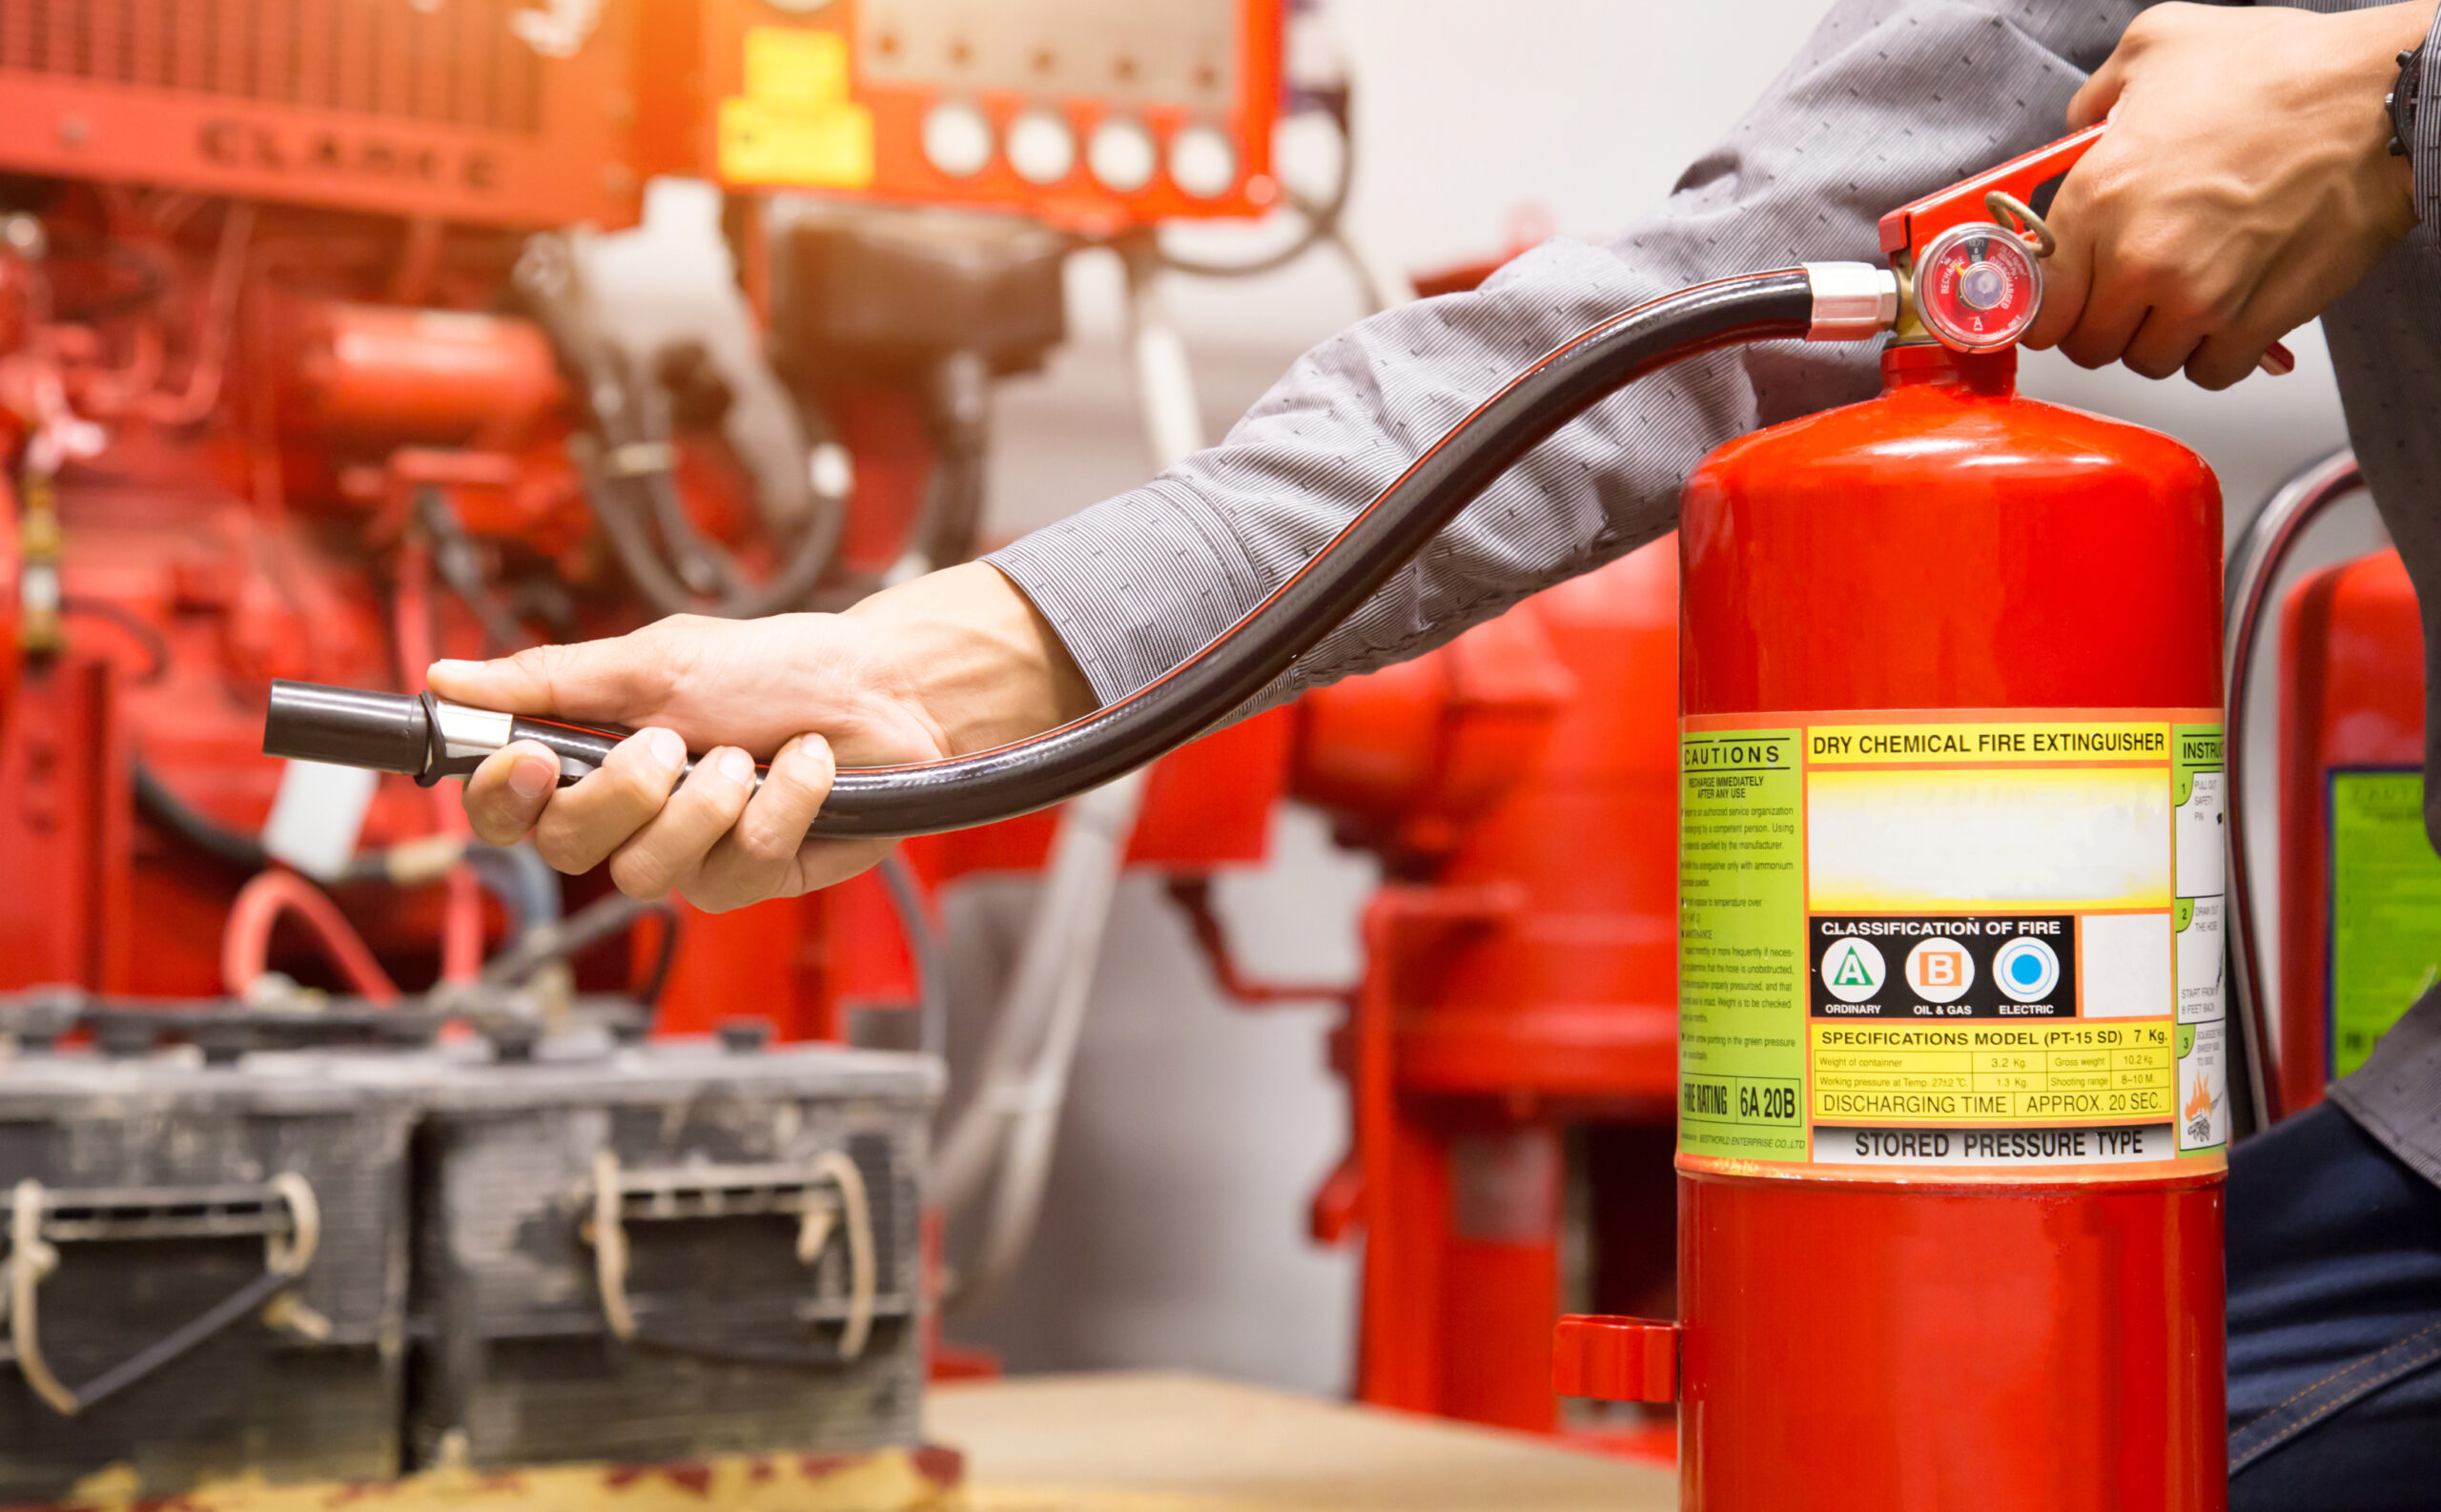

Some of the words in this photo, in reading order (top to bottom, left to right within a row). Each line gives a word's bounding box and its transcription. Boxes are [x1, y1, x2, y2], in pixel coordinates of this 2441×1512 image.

[1940, 255, 1965, 295] RECHARGE
[1814, 736, 1852, 754] DRY
[1859, 734, 1971, 753] CHEMICAL
[1979, 734, 2026, 752] FIRE
[2033, 733, 2164, 751] EXTINGUISHER
[1684, 746, 1779, 766] CAUTIONS
[1689, 777, 1715, 787] RECHARGE
[1716, 776, 1764, 787] IMMEDIATELY
[1697, 788, 1714, 799] AFTER
[1716, 788, 1729, 799] ANY
[1731, 788, 1746, 799] USE
[2181, 783, 2185, 794] 1
[1729, 807, 1749, 816] service
[1751, 807, 1794, 818] organization
[1744, 825, 1770, 835] person.
[1772, 823, 1795, 835] Using
[1729, 840, 1738, 849] the
[1739, 840, 1784, 850] manufacturer.
[1741, 861, 1753, 870] with
[1754, 861, 1794, 870] ammonium
[1747, 899, 1763, 908] over
[2182, 908, 2187, 920] 2
[1821, 922, 1980, 935] CLASSIFICATION
[1985, 921, 2013, 935] OF
[2018, 921, 2061, 934] FIRE
[1732, 948, 1762, 958] frequently
[1770, 948, 1795, 957] neces-
[1748, 965, 1795, 974] unobstructed,
[1838, 953, 1867, 985] A
[1928, 953, 1955, 985] B
[1766, 982, 1777, 991] and
[1779, 982, 1793, 991] that
[2182, 988, 2201, 999] START
[1751, 999, 1760, 1008] be
[1761, 999, 1792, 1009] checked
[1825, 1004, 1881, 1014] ORDINARY
[1914, 1005, 1933, 1014] OIL
[1936, 1005, 1944, 1014] &
[1946, 1005, 1972, 1014] GAS
[1999, 1005, 2054, 1014] ELECTRIC
[2187, 1003, 2202, 1014] FEET
[1733, 1036, 1743, 1046] the
[1744, 1037, 1763, 1048] green
[1764, 1037, 1796, 1048] pressure
[1821, 1031, 1969, 1046] SPECIFICATIONS
[1975, 1032, 2040, 1046] MODEL
[2043, 1031, 2092, 1048] (PT-15
[2097, 1030, 2123, 1046] SD)
[2134, 1030, 2142, 1043] 7
[2148, 1029, 2168, 1044] Kg.
[2184, 1037, 2189, 1050] 3
[1819, 1057, 1847, 1068] Weight
[1849, 1057, 1857, 1067] of
[1991, 1057, 2009, 1068] 3.2
[2055, 1058, 2079, 1067] Gross
[2081, 1057, 2105, 1068] weight
[2123, 1054, 2143, 1065] 10.2
[1819, 1077, 1852, 1088] Working
[1854, 1078, 1891, 1088] pressure
[1893, 1078, 1901, 1087] at
[1903, 1077, 1928, 1088] Temp.
[1997, 1078, 2010, 1087] 1.3
[2050, 1077, 2085, 1088] Shooting
[2087, 1077, 2108, 1088] range
[1684, 1083, 1695, 1113] FIRE
[1696, 1084, 1728, 1115] RATING
[1740, 1086, 1760, 1117] 6A
[1764, 1087, 1795, 1119] 20B
[1823, 1093, 1956, 1114] DISCHARGING
[1961, 1095, 2007, 1114] TIME
[2026, 1094, 2104, 1113] APPROX.
[2109, 1093, 2126, 1111] 20
[2130, 1092, 2163, 1111] SEC.
[1732, 1135, 1774, 1148] ENTERPRISE
[1856, 1132, 1950, 1157] STORED
[1964, 1132, 2085, 1157] PRESSURE
[2097, 1130, 2144, 1155] TYPE
